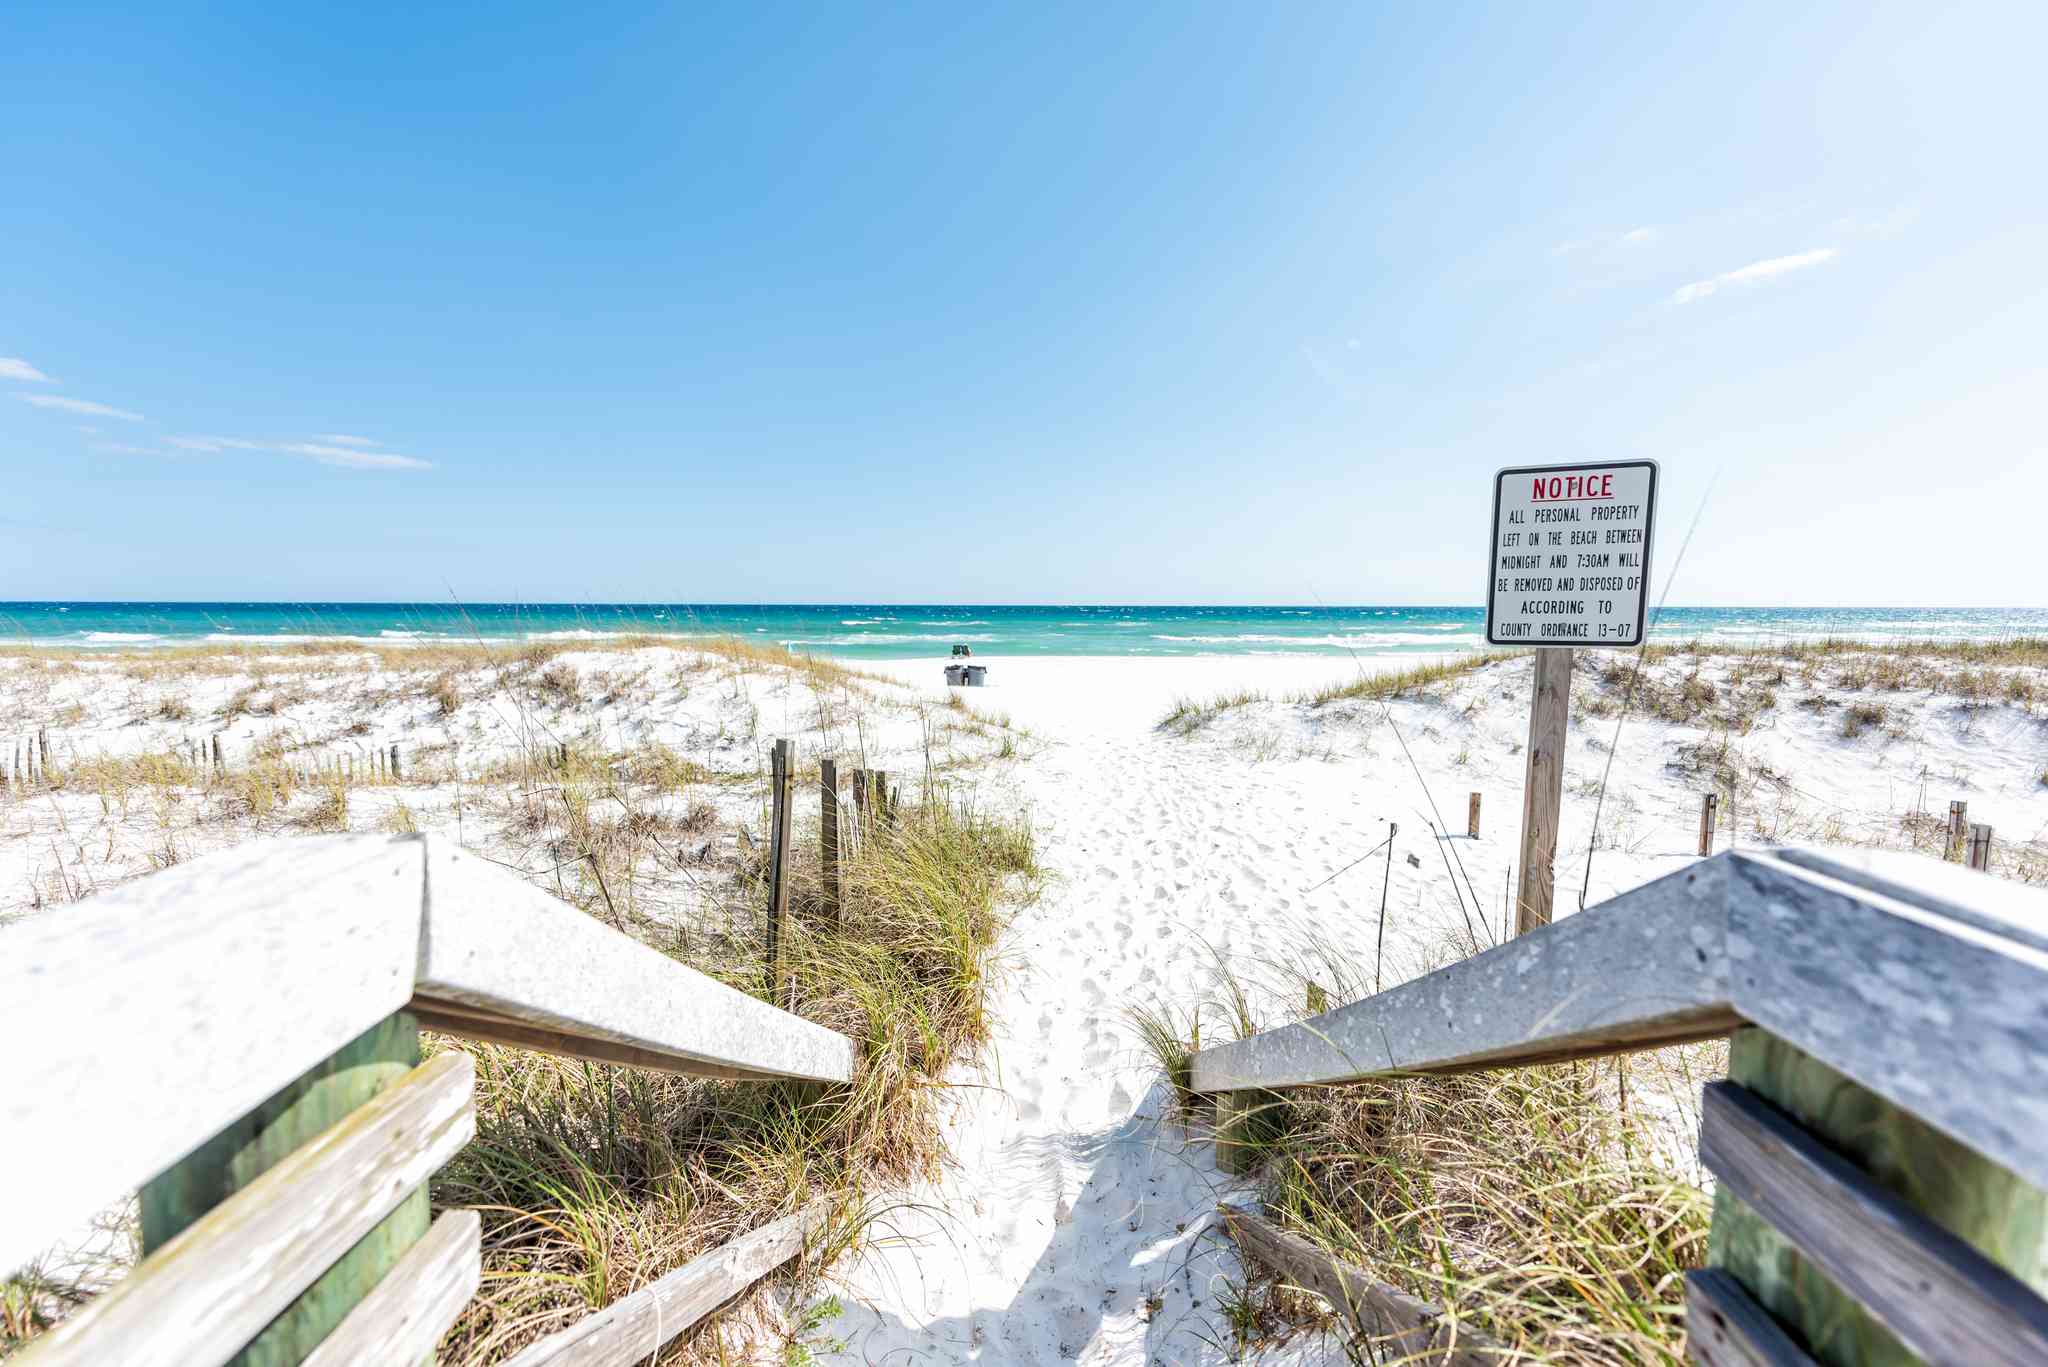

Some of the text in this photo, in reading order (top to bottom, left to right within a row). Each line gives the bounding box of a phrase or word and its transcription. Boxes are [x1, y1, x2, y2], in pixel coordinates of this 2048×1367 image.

[1533, 475, 1613, 499] NOTICE
[1509, 505, 1639, 523] ALL PERSONAL PROPERTY
[1503, 529, 1642, 546] LEFT ON THE BEACH BETWEEN
[1502, 553, 1639, 569] MIDNIGHT AND 7:30AM WILL
[1498, 577, 1640, 591] BE REMOVED AND DISPOSED OF
[1521, 601, 1612, 614] ACCORDING TO
[1501, 623, 1630, 637] COUNTY ORDINANCE 13-07
